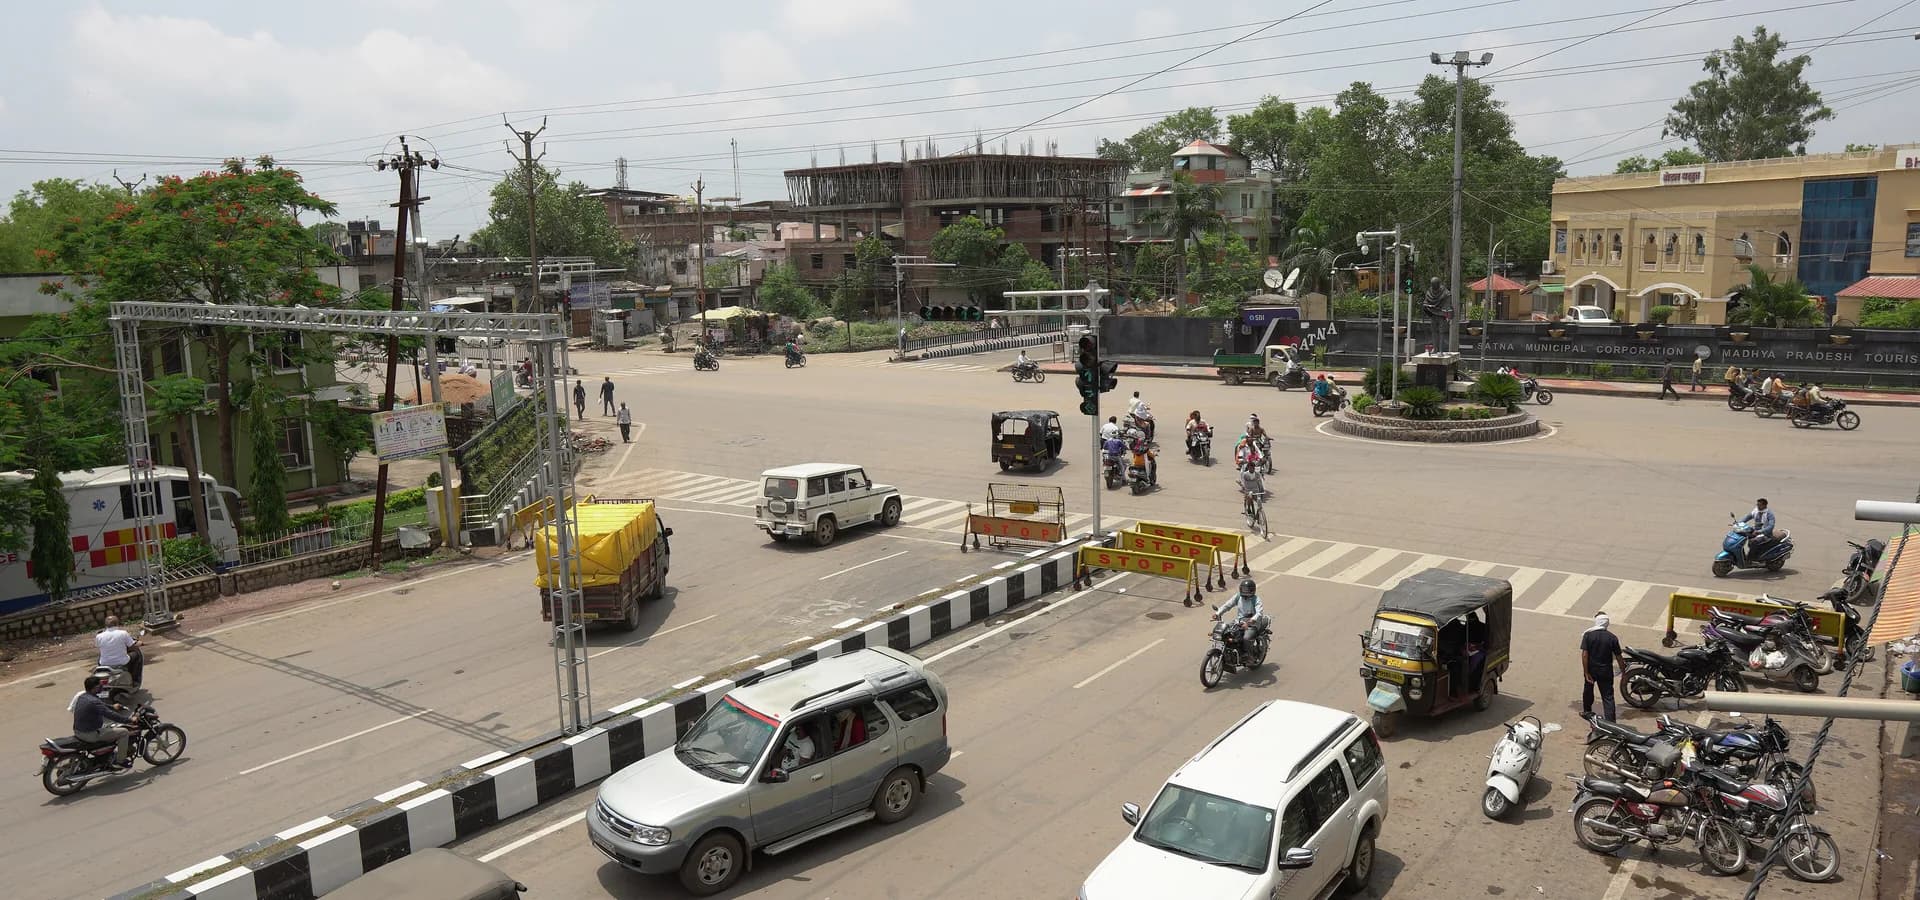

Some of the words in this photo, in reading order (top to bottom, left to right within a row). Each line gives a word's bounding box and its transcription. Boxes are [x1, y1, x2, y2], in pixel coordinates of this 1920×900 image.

[1477, 343, 1514, 351] SATNA
[1525, 343, 1586, 353] MUNICIPAL
[1597, 345, 1684, 356] CORPORATION
[1722, 349, 1776, 359] MADHYA
[1786, 351, 1852, 361] PRADESH
[1864, 353, 1919, 364] TOURIS
[984, 524, 1048, 540] STOP
[1134, 538, 1200, 557] STOP
[1098, 554, 1174, 573] STOP
